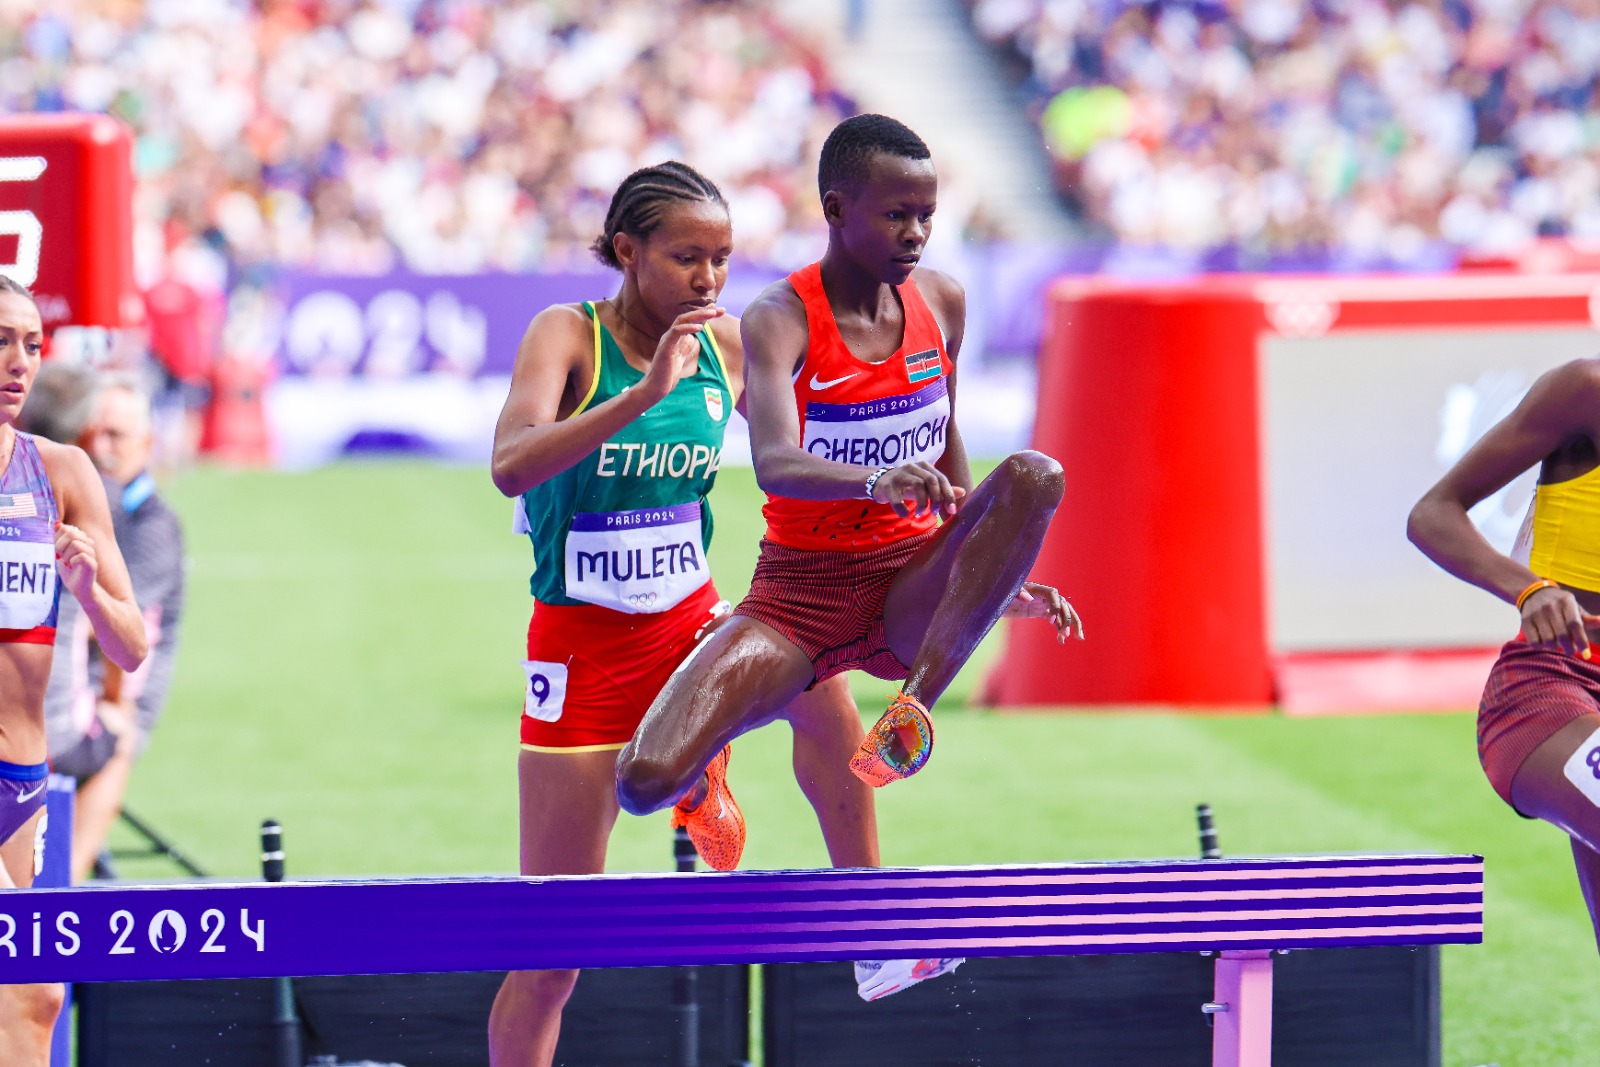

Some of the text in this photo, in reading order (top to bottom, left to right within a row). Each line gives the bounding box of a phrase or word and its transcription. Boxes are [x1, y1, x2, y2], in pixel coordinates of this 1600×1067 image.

[890, 396, 922, 410] 2024
[808, 416, 947, 466] CHEROTICH
[645, 511, 675, 523] 2024
[0, 561, 51, 594] ENT
[577, 541, 700, 582] MULETA
[530, 673, 550, 707] 9
[108, 908, 265, 955] 2024
